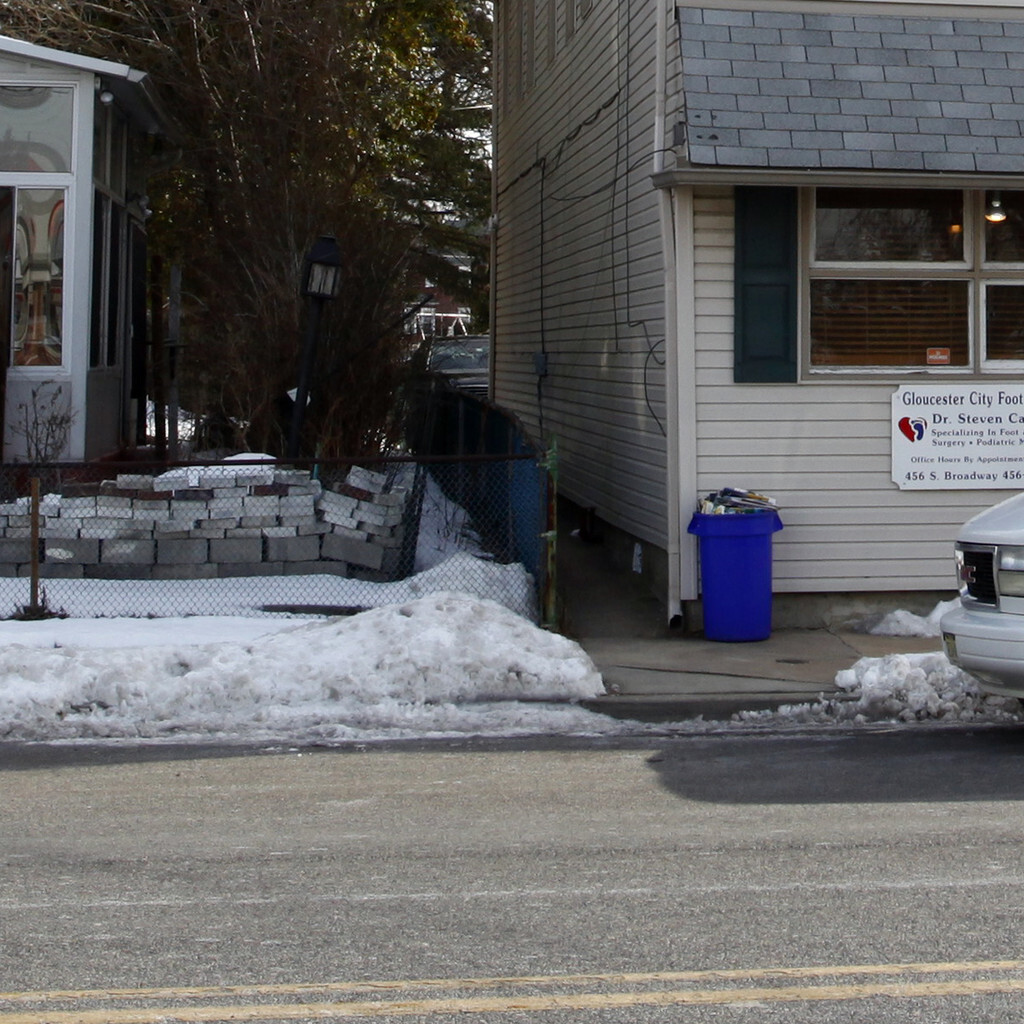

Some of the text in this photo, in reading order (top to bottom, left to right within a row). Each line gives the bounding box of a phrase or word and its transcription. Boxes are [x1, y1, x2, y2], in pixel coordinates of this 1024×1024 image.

[903, 392, 964, 405] Gloucester
[970, 391, 992, 408] City
[998, 391, 1023, 405] Foot
[932, 414, 952, 424] Dr.
[958, 413, 1002, 424] Steven
[932, 429, 984, 437] Specializing
[905, 472, 924, 481] 456
[930, 472, 939, 481] S.
[945, 472, 998, 481] Broadway
